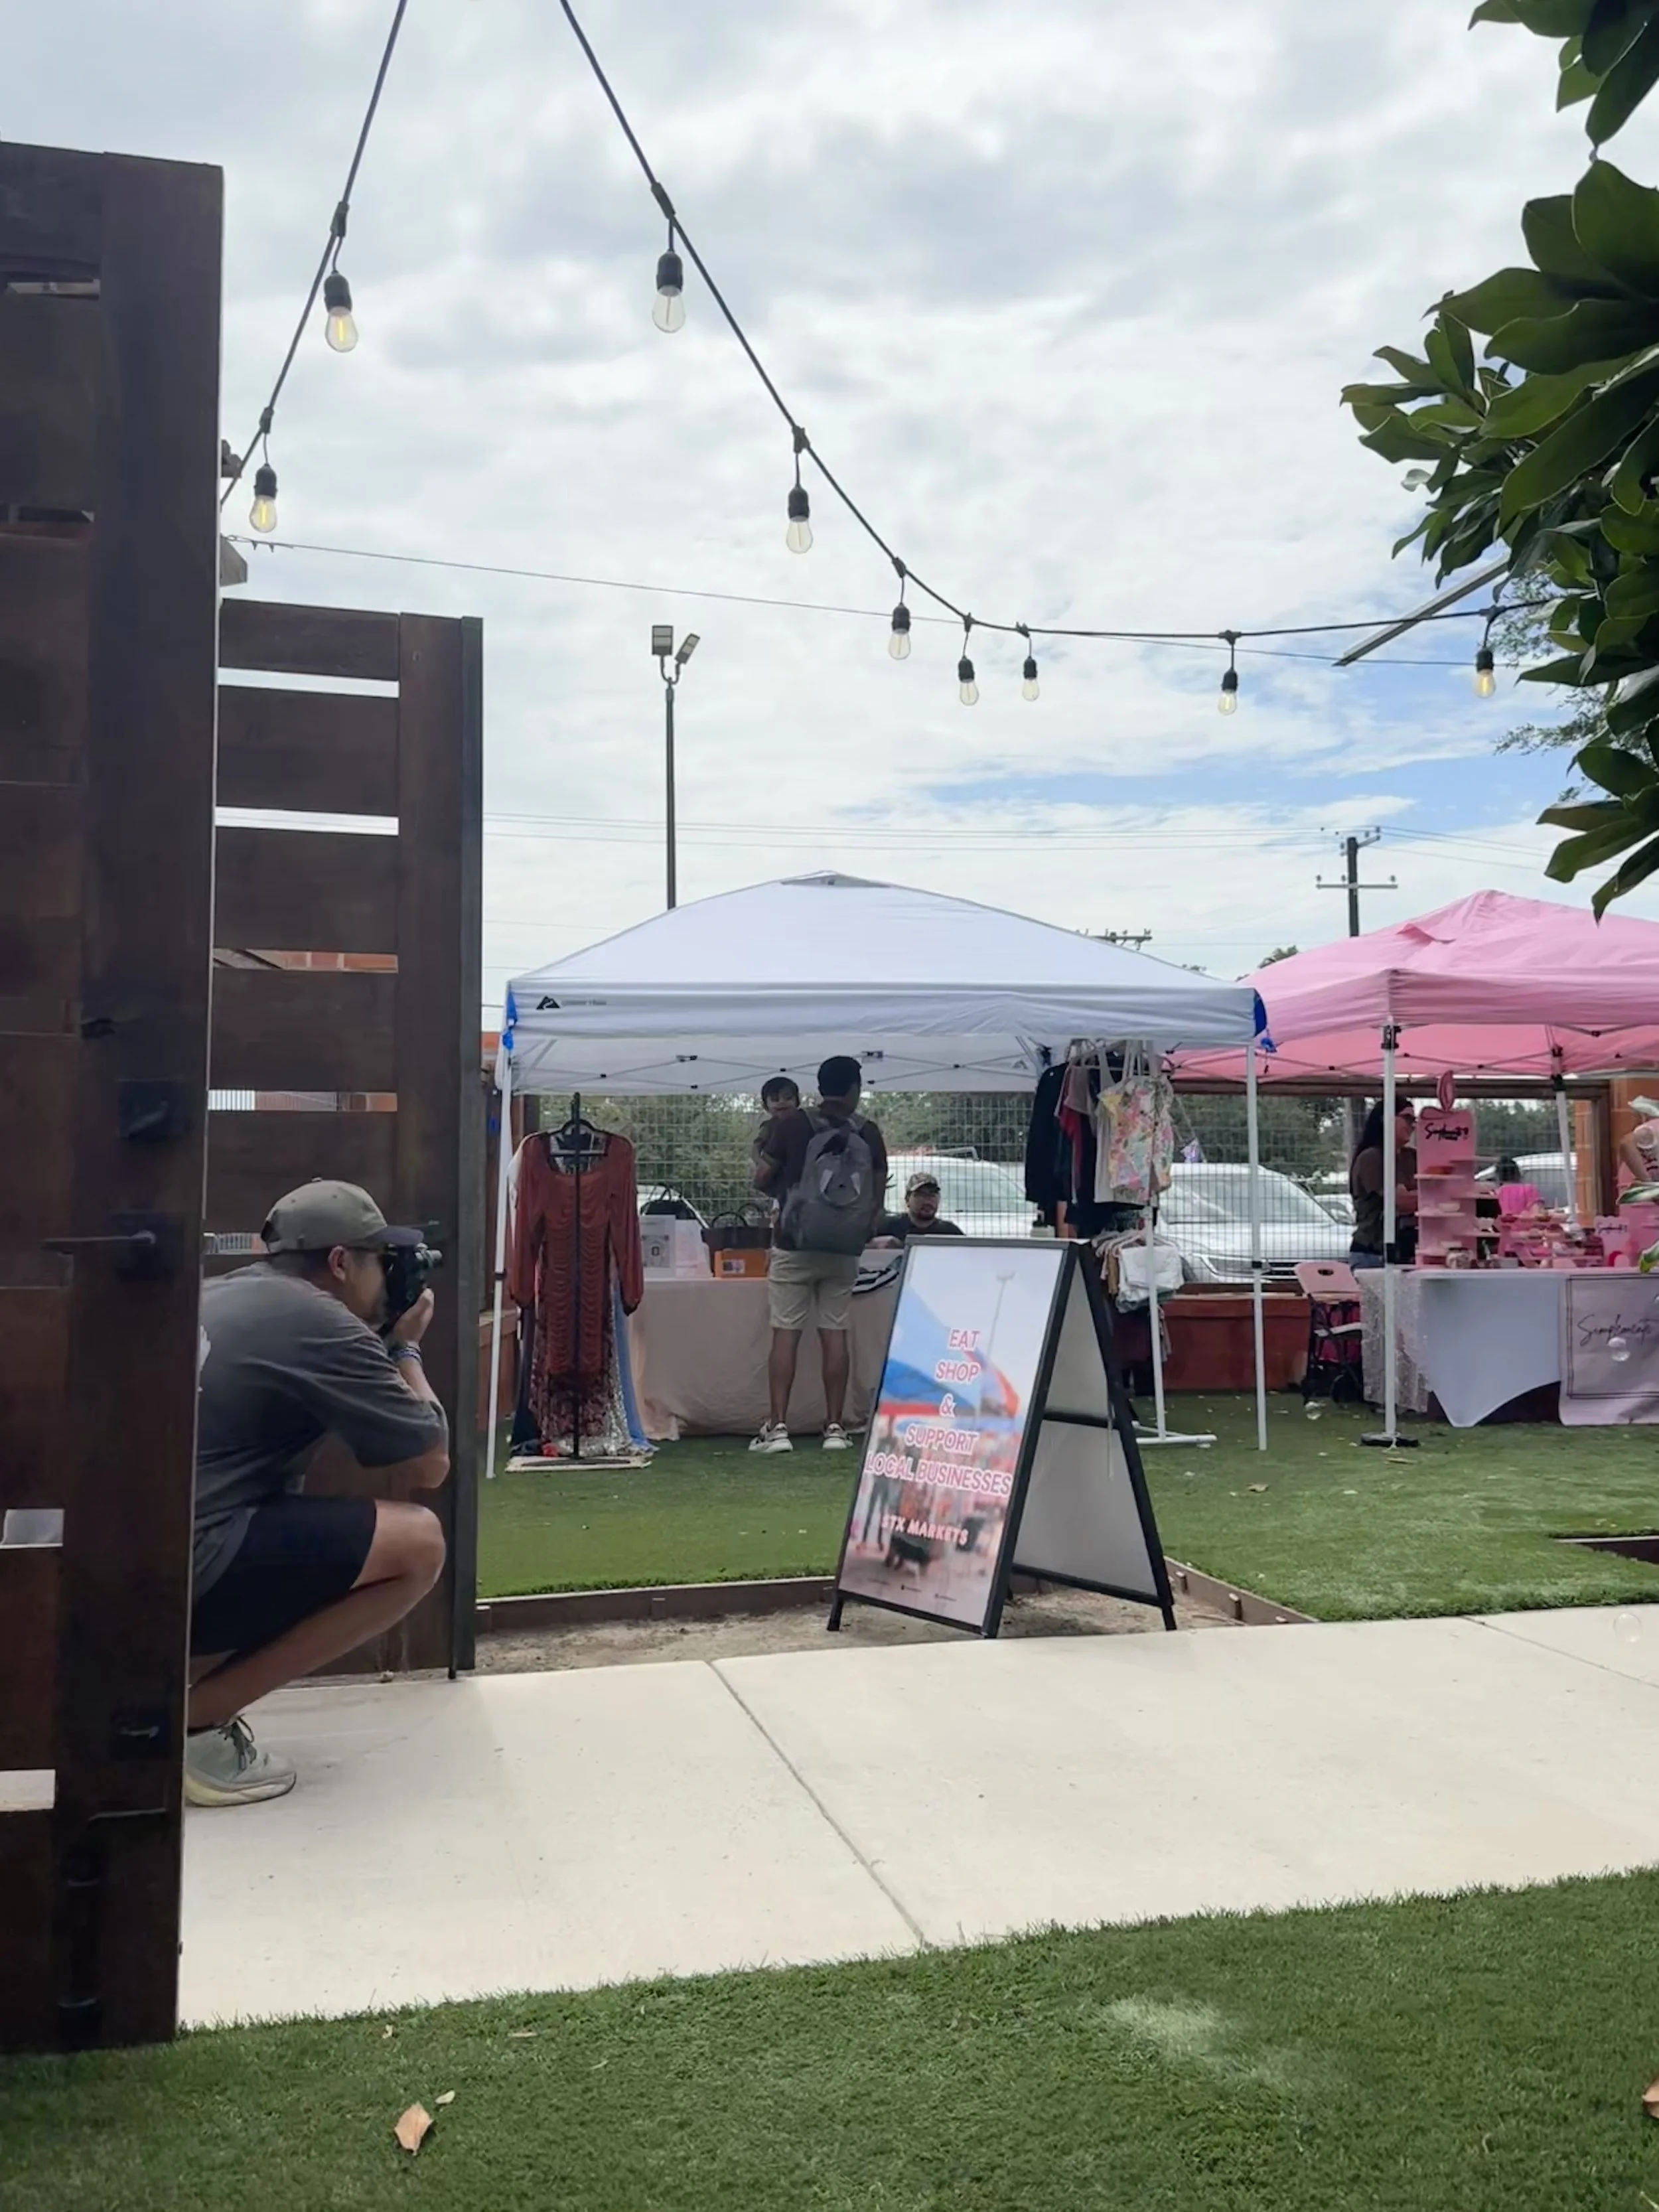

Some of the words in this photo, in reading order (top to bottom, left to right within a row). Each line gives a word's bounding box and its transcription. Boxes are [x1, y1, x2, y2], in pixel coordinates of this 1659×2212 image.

[948, 1329, 980, 1349] EAT
[936, 1361, 980, 1382] SHOP
[940, 1394, 956, 1416] &
[905, 1425, 978, 1453] SUPPORT
[865, 1451, 913, 1480] LOCAL
[916, 1460, 1012, 1495] BUSINESSES
[906, 1518, 969, 1546] MARKETS
